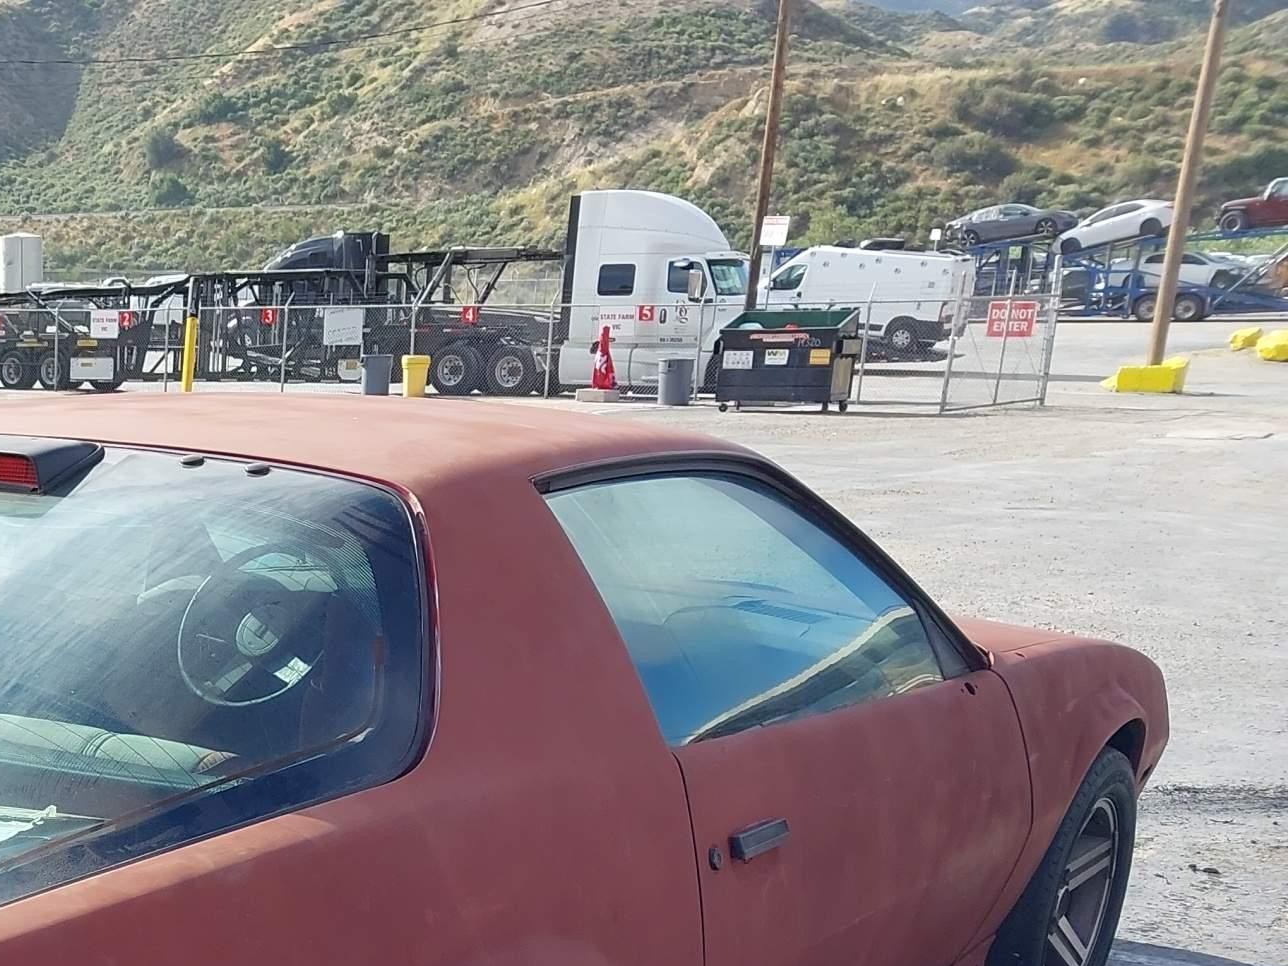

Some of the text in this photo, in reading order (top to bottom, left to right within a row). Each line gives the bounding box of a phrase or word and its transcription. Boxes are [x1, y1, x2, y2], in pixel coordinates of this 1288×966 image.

[122, 312, 130, 326] 2
[264, 310, 273, 323] 3
[465, 307, 473, 321] 4
[641, 305, 652, 321] 5
[992, 309, 1034, 319] DO NOT
[993, 321, 1029, 332] ENTER
